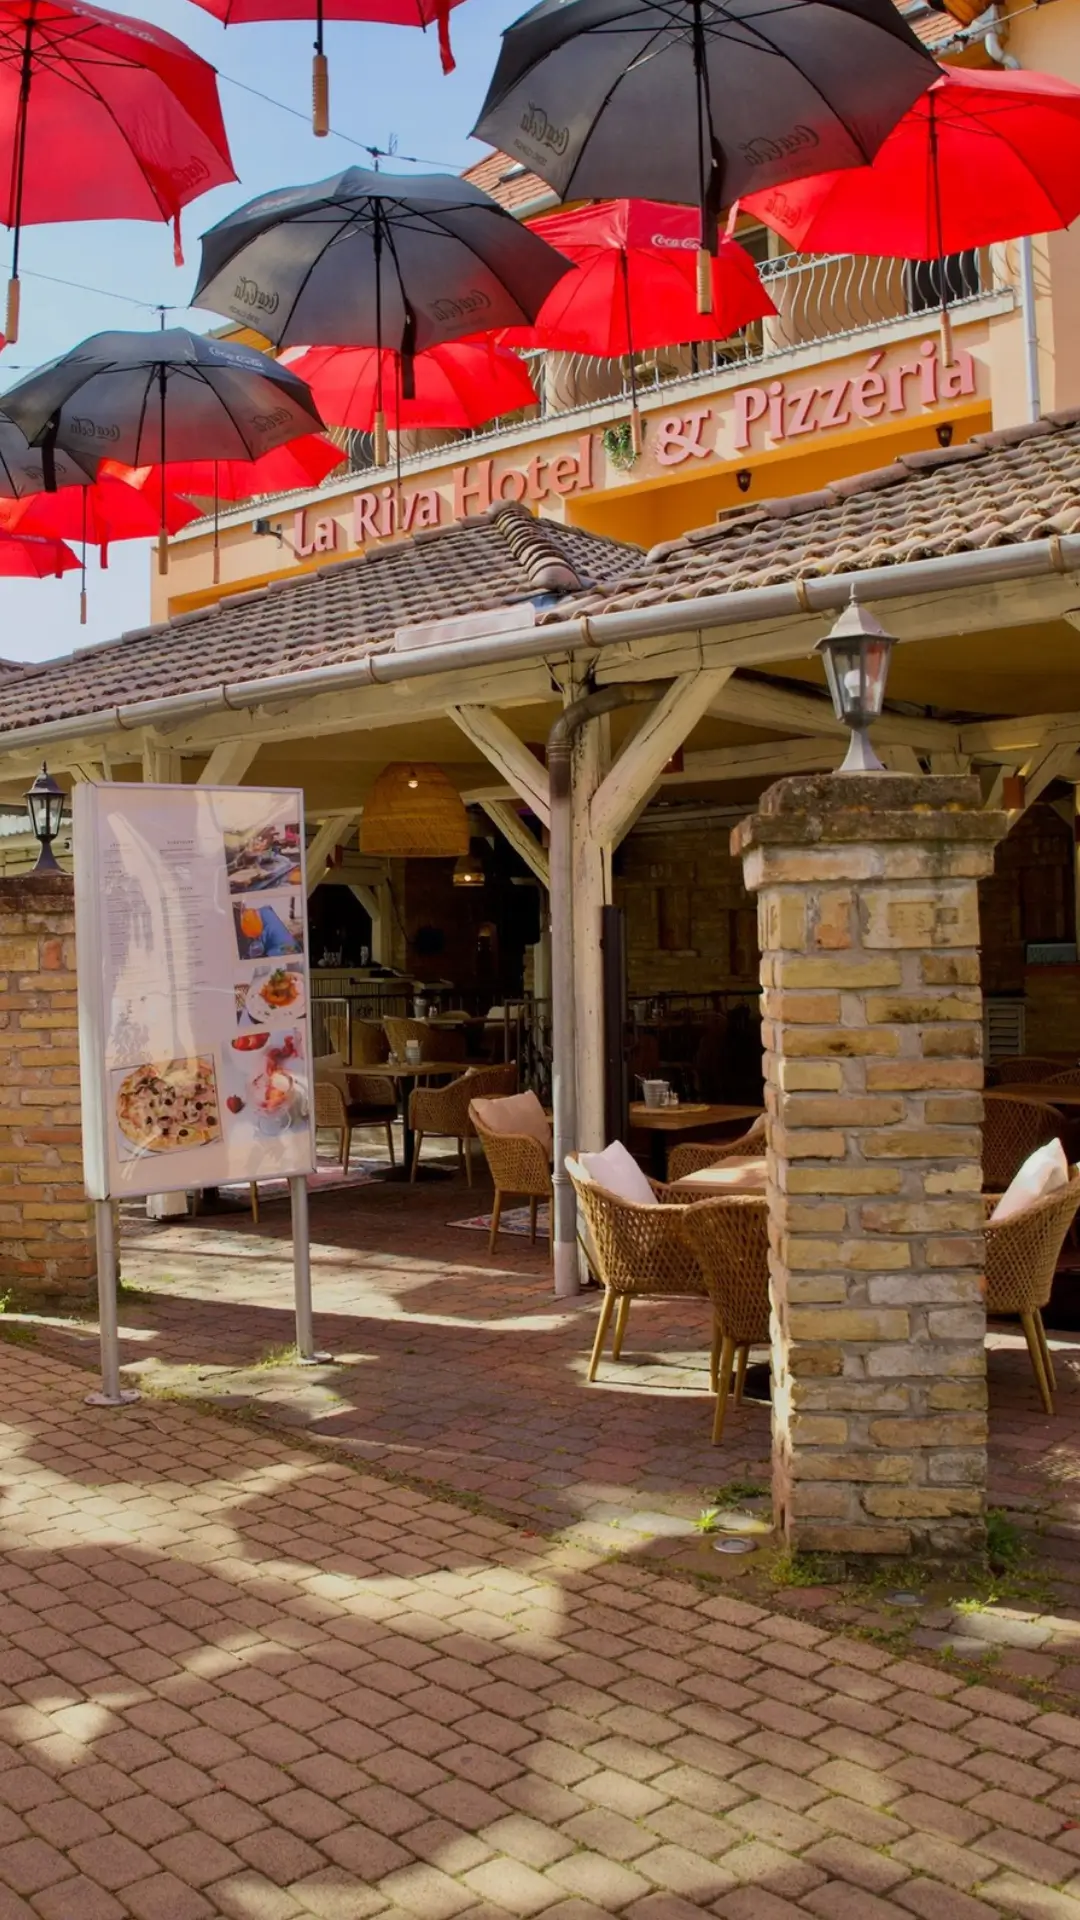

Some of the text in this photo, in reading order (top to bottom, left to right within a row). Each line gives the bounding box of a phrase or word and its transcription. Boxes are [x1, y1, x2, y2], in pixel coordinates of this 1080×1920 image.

[293, 340, 976, 557] La Riva Hotel & Pizzéria
